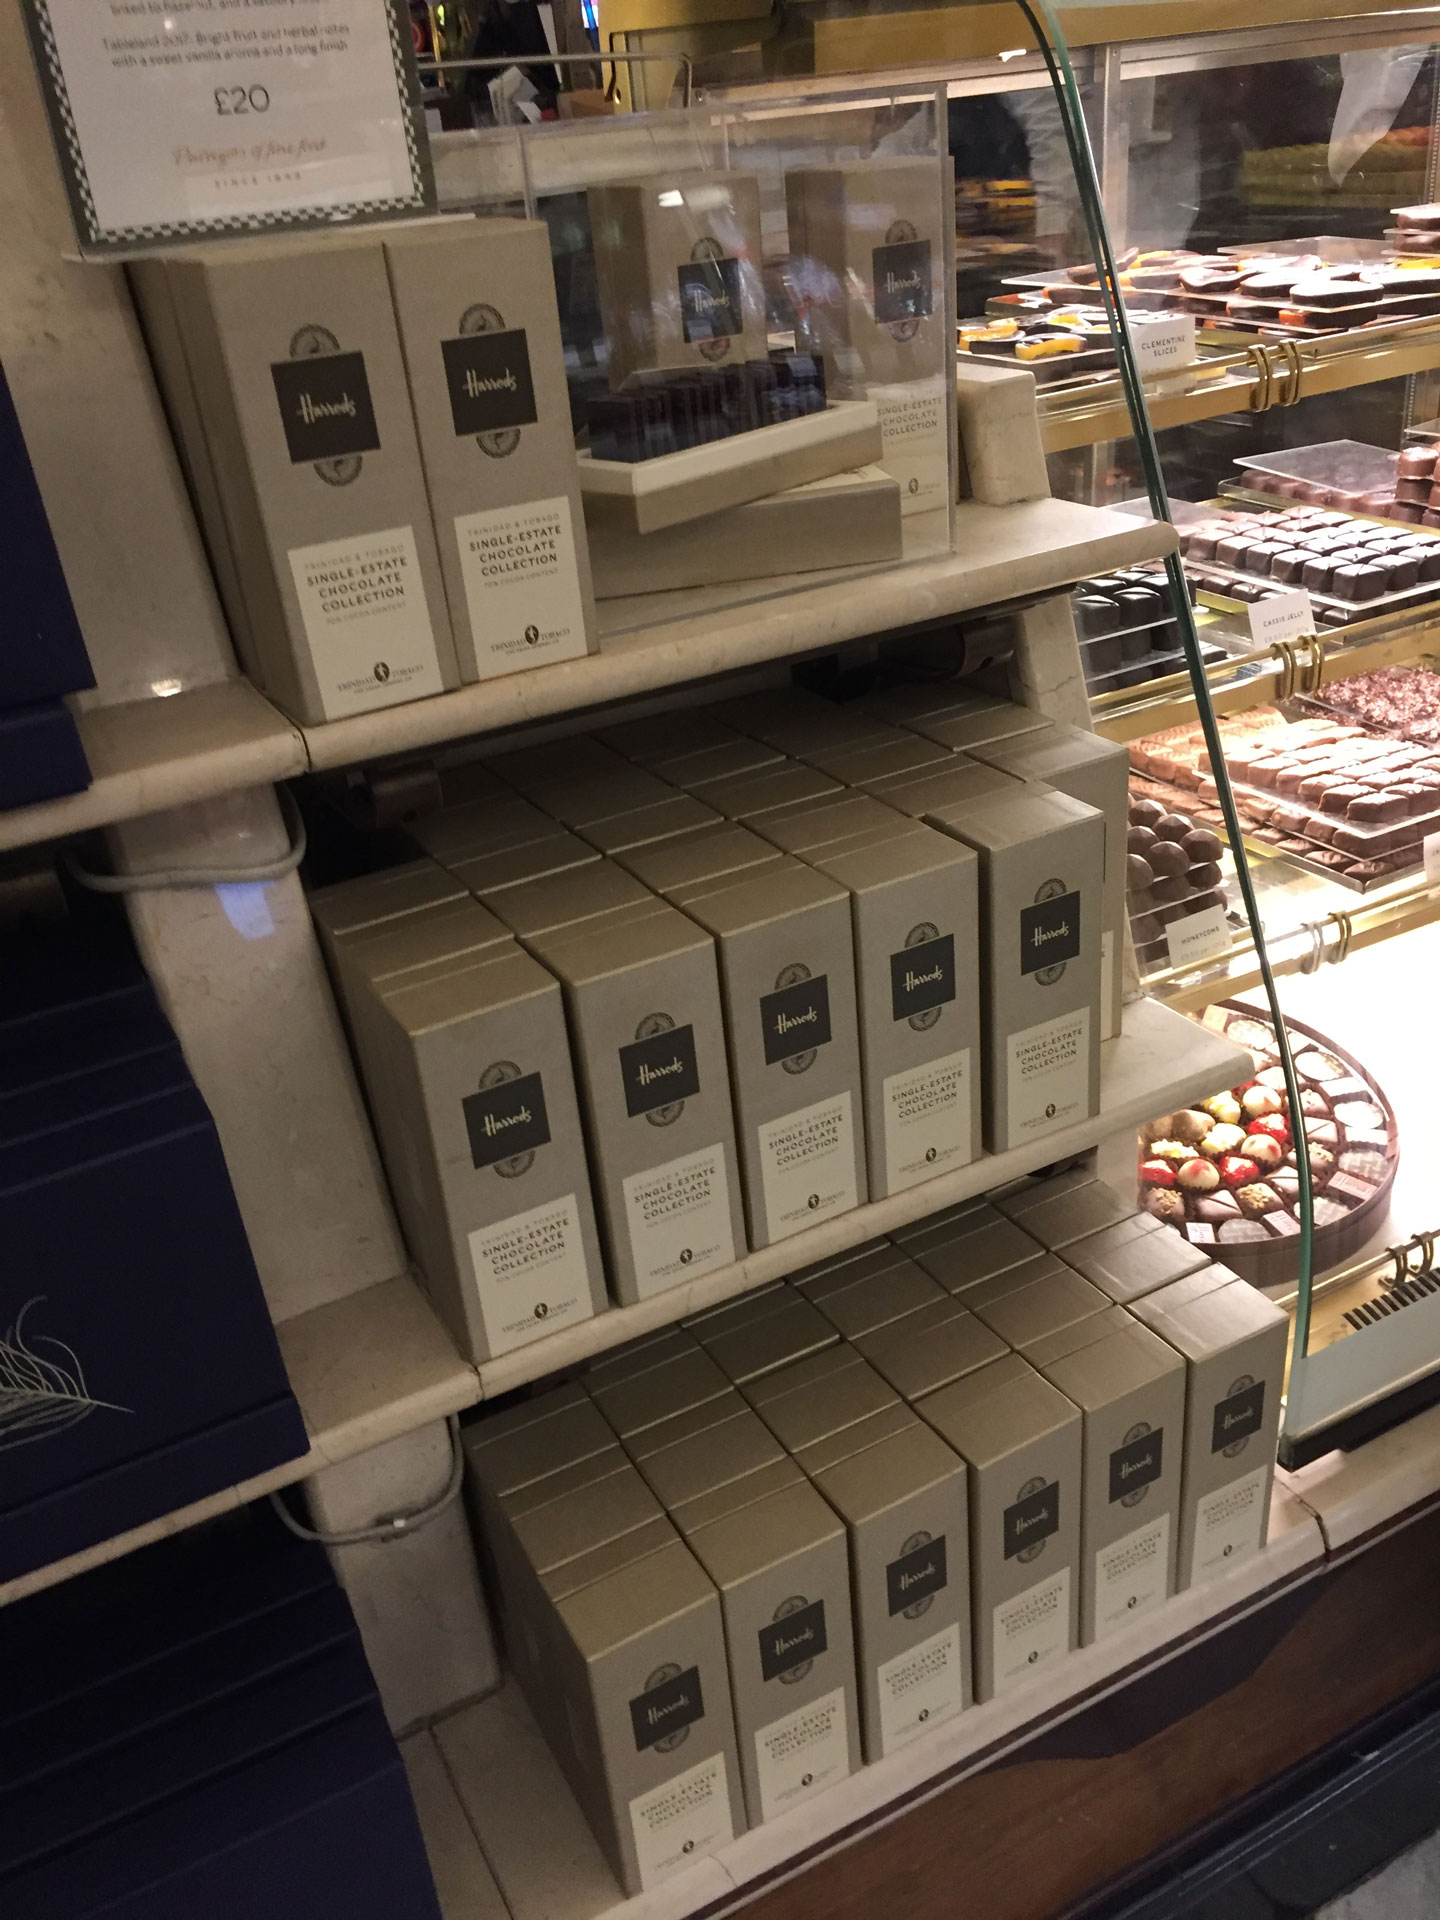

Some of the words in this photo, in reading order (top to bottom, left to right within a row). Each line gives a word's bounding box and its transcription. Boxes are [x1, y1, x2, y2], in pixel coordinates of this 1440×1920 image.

[214, 84, 270, 116] £20
[462, 368, 517, 398] Harrods
[297, 392, 356, 424] Harrods
[469, 525, 562, 552] SINGLE-ESTATE
[479, 539, 556, 564] CHOCOLATE
[307, 556, 408, 587] SINGLE-ESTATE
[481, 553, 558, 577] COLLECTION
[318, 572, 402, 599] CHOCOLATE
[321, 585, 405, 613] COLLECTION
[1030, 921, 1069, 947] Harrods
[902, 964, 943, 992] Harrods
[773, 1006, 817, 1035] Harrods
[635, 1056, 683, 1086] Harrods
[892, 1070, 963, 1102] SINGLE-ESTATE
[898, 1081, 957, 1109] CHOCOLATE
[898, 1091, 958, 1119] COLLECTION
[480, 1105, 532, 1137] Harrods
[768, 1114, 843, 1150] SINGLE-ESTATE
[776, 1126, 838, 1157] CHOCOLATE
[776, 1136, 839, 1166] COLLECTION
[634, 1166, 716, 1203] SINGLE-ESTATE
[642, 1179, 710, 1210] CHOCOLATE
[643, 1189, 711, 1220] COLLECTION
[482, 1218, 569, 1258] SINGLE-ESTATE
[491, 1230, 564, 1265] CHOCOLATE
[493, 1241, 565, 1275] COLLECTION
